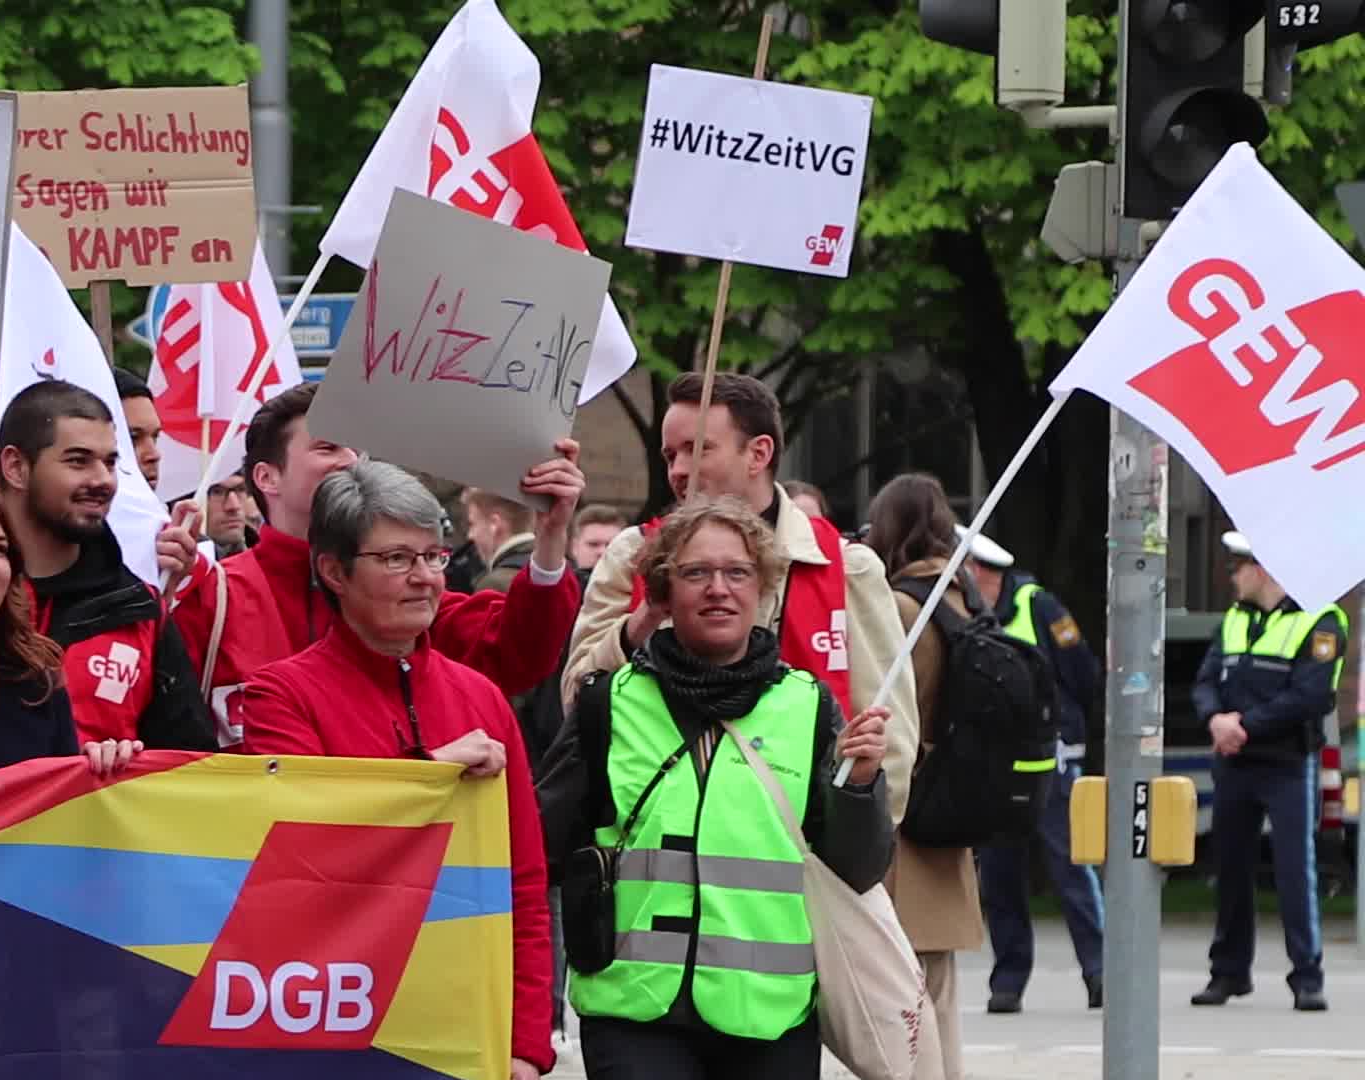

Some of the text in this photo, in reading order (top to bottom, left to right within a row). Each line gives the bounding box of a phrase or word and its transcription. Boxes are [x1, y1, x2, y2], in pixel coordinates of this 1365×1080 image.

[1279, 4, 1320, 26] 532
[80, 112, 250, 166] Schlichtung
[651, 118, 855, 176] #WitzZeitVG
[125, 168, 169, 207] wir
[68, 226, 180, 272] KAMPF
[191, 239, 233, 263] an
[805, 235, 844, 254] GEW
[812, 631, 846, 653] GE
[88, 655, 140, 688] GEW
[1134, 784, 1147, 855] 547
[209, 960, 373, 1034] DGB
